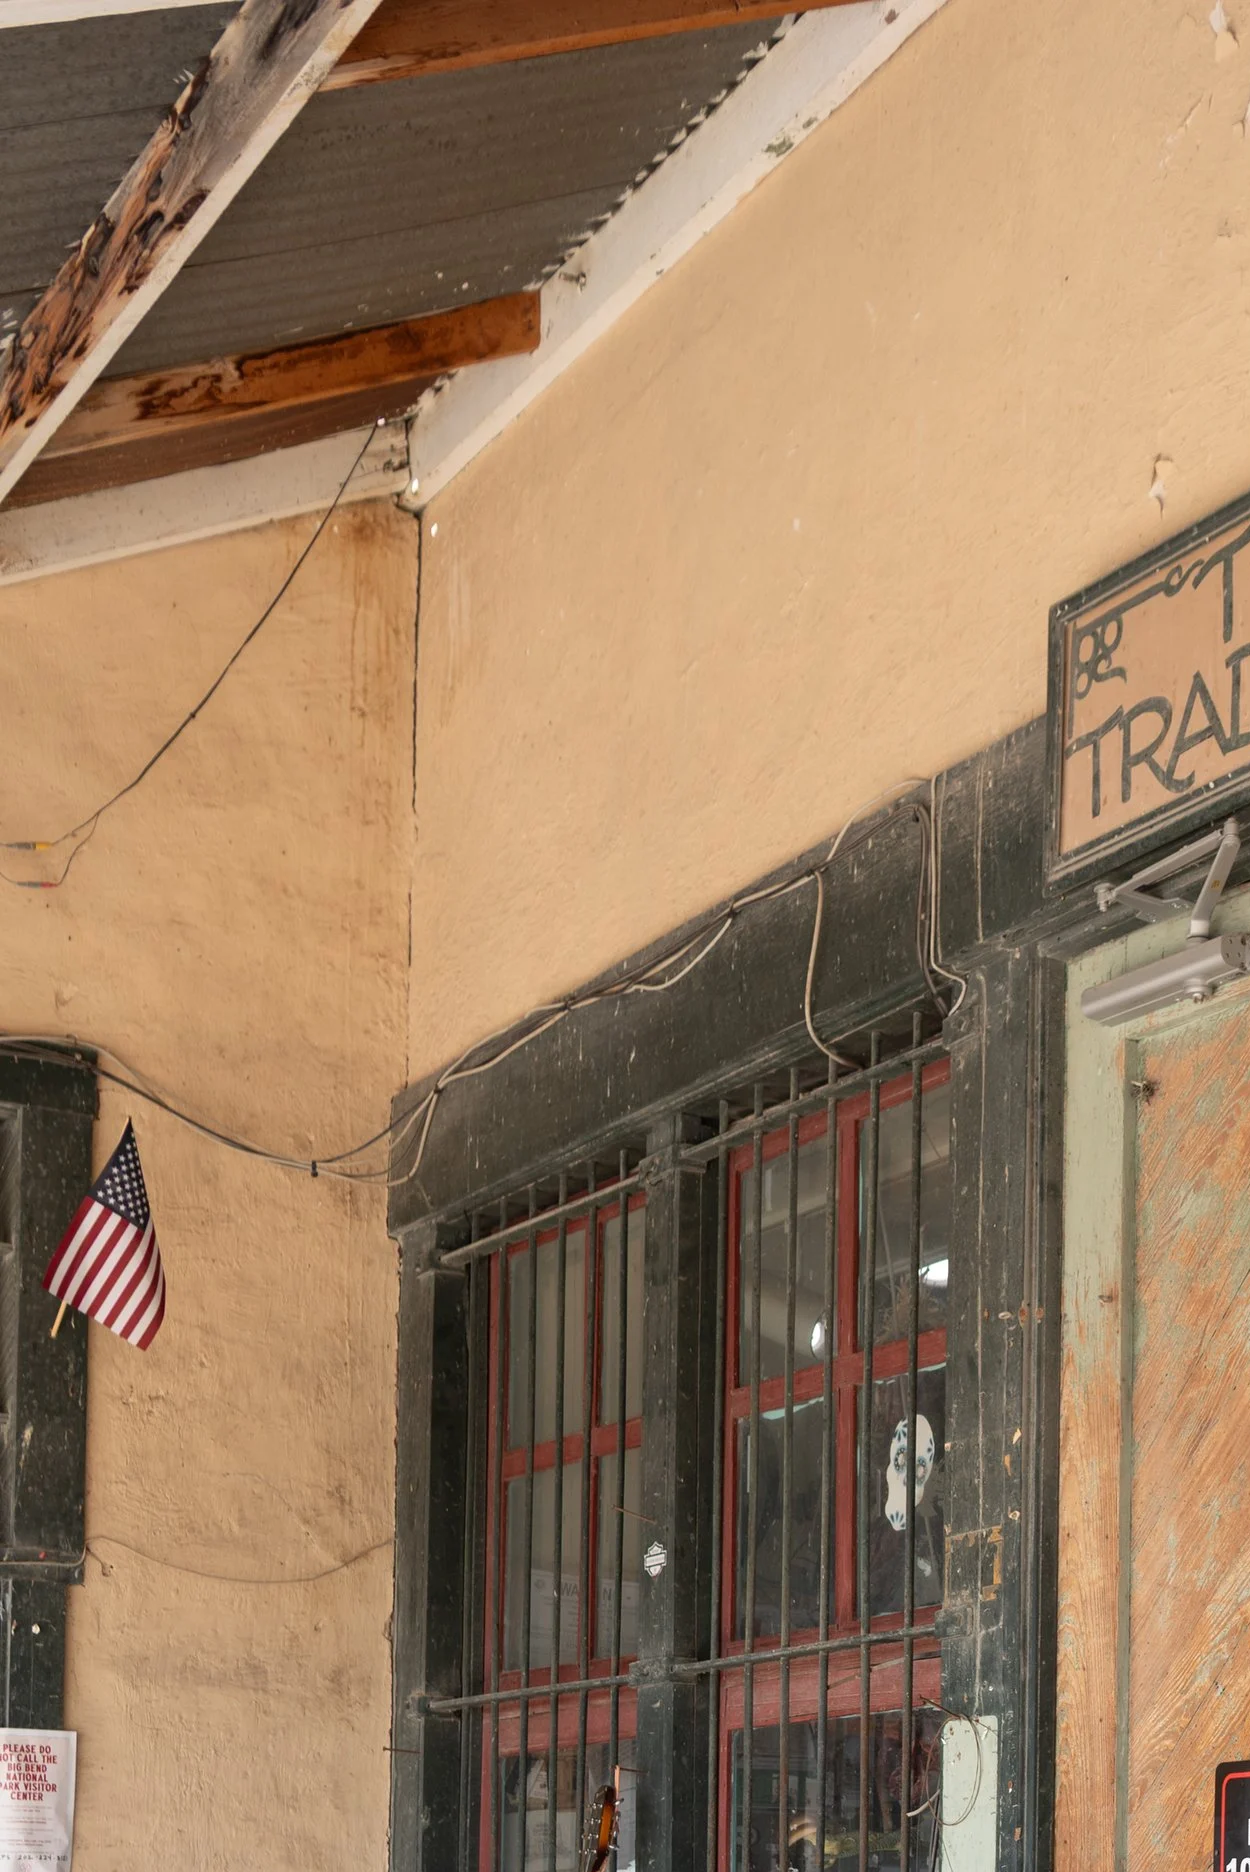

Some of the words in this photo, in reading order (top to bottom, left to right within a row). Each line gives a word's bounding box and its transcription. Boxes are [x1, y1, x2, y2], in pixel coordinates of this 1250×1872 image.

[3, 1744, 36, 1753] PLEASE
[39, 1745, 51, 1754] DO
[17, 1754, 38, 1763] CALL
[42, 1755, 57, 1764] THE
[7, 1763, 22, 1771] BIG
[25, 1763, 47, 1773] BEND
[6, 1772, 48, 1782] NATIONAL
[23, 1782, 57, 1792] VISITOR
[11, 1791, 43, 1801] CENTER
